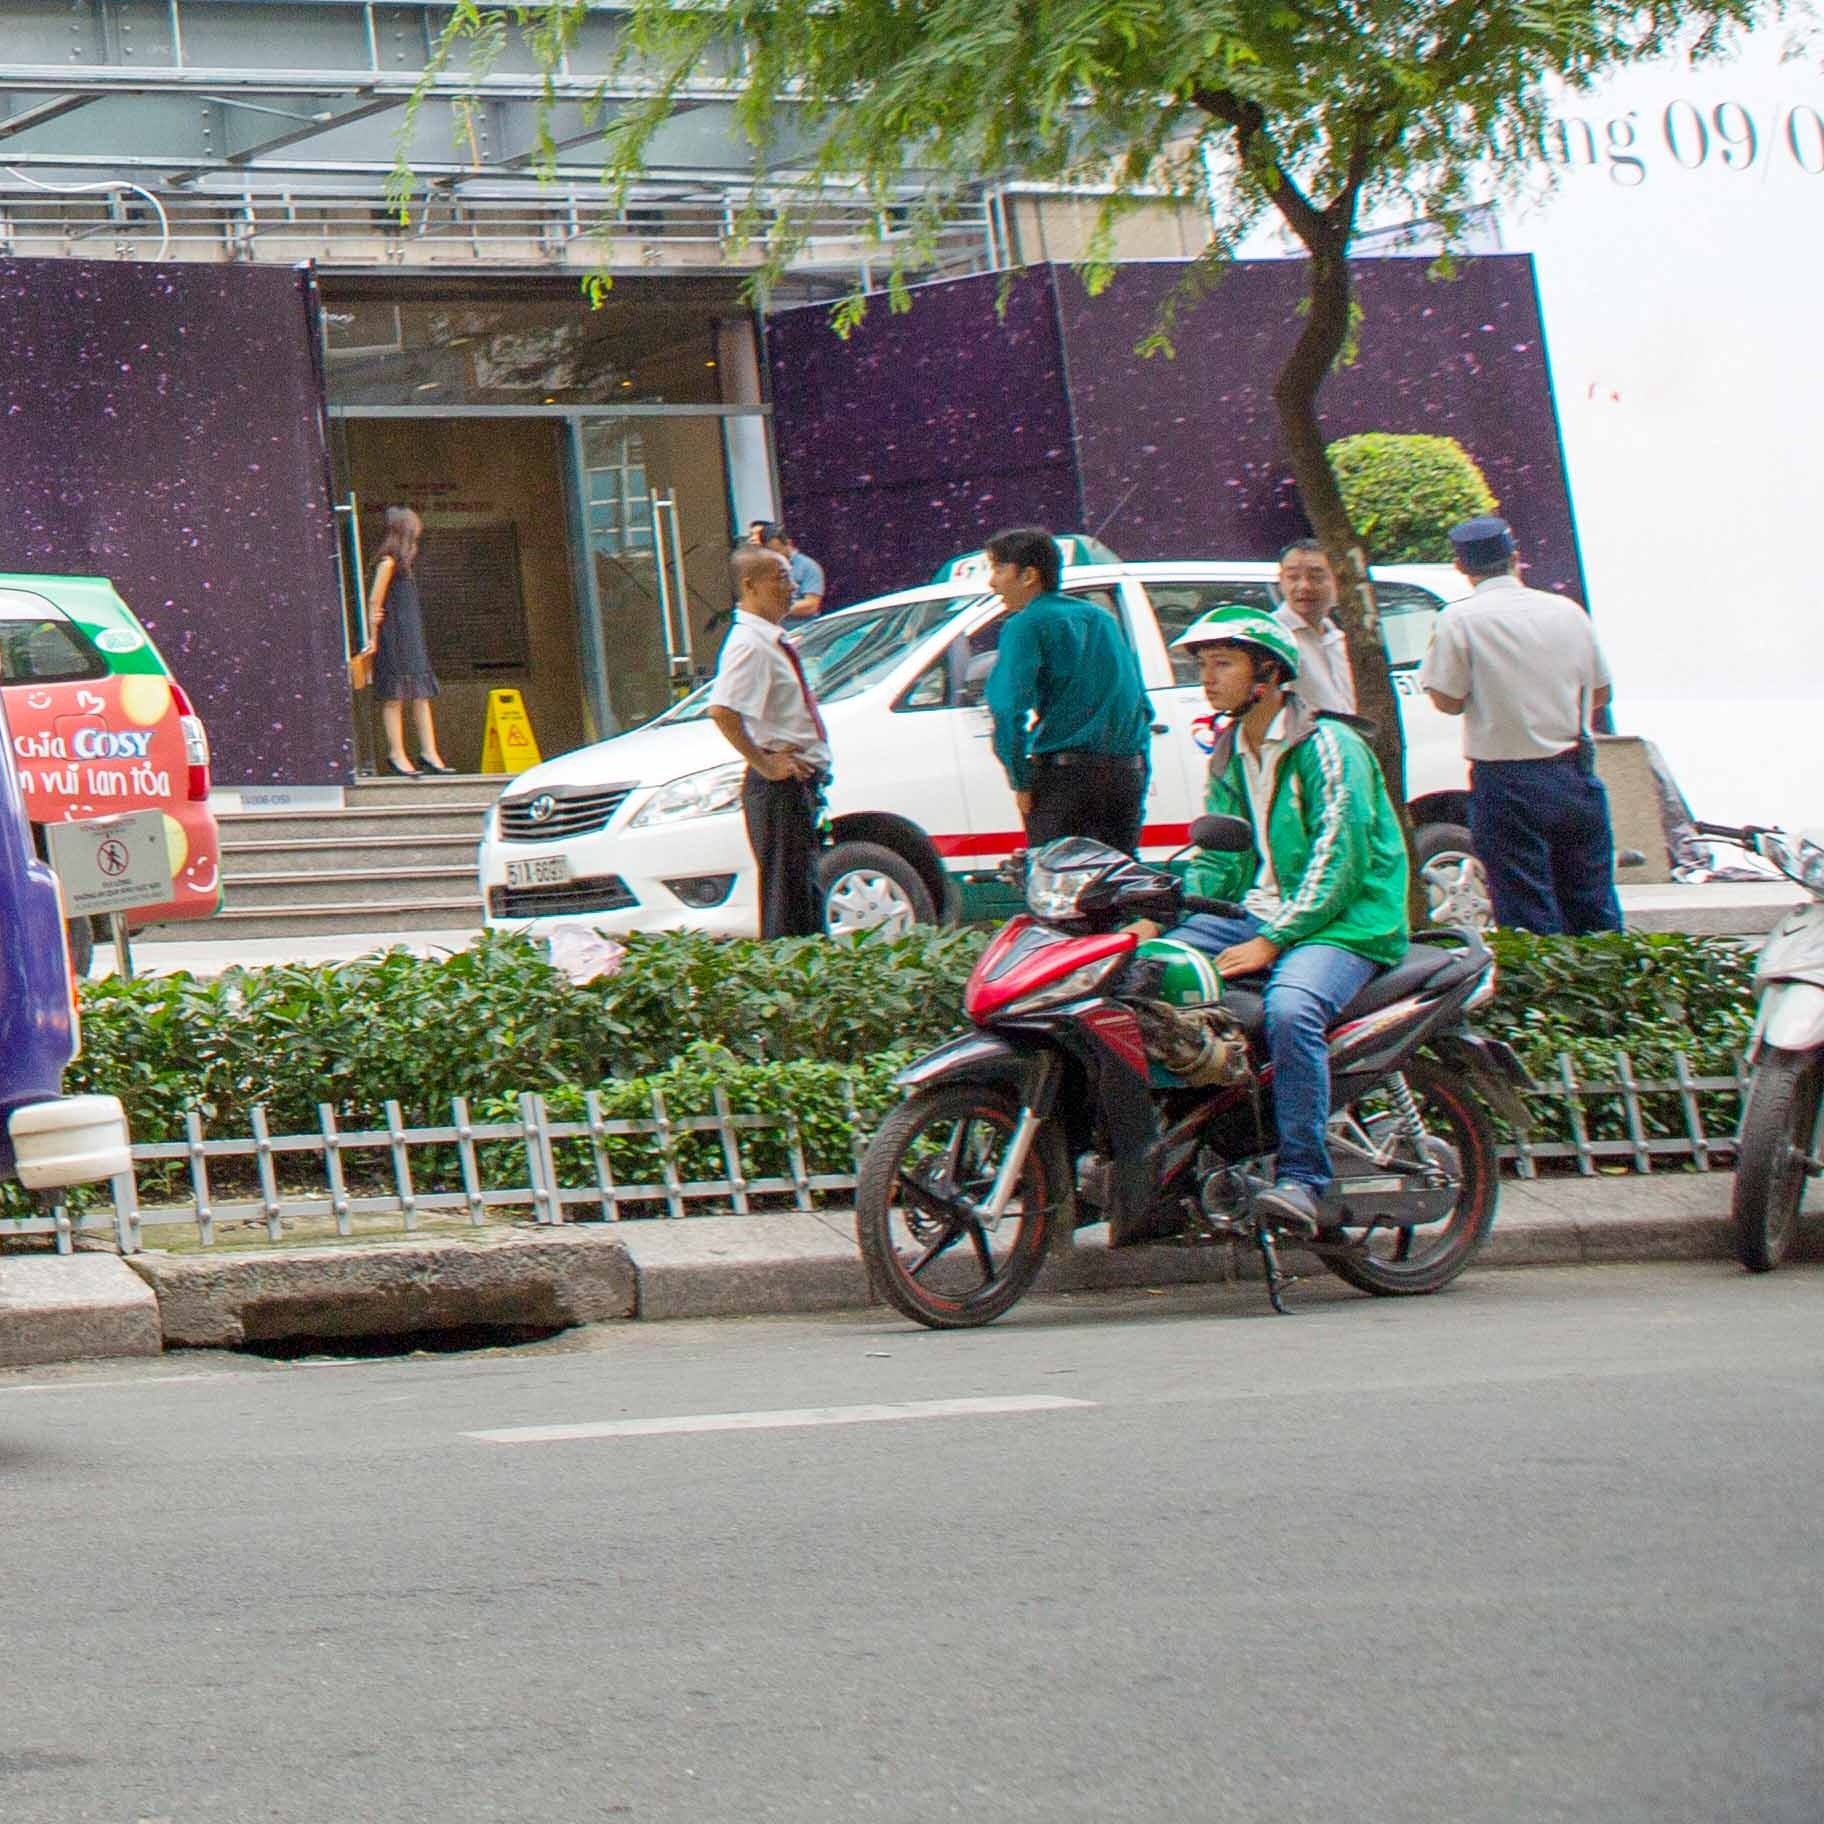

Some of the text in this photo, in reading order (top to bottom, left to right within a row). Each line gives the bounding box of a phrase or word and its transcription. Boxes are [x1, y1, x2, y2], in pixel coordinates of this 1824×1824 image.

[73, 728, 154, 759] COSY
[41, 762, 80, 796] vui
[87, 767, 128, 797] lan
